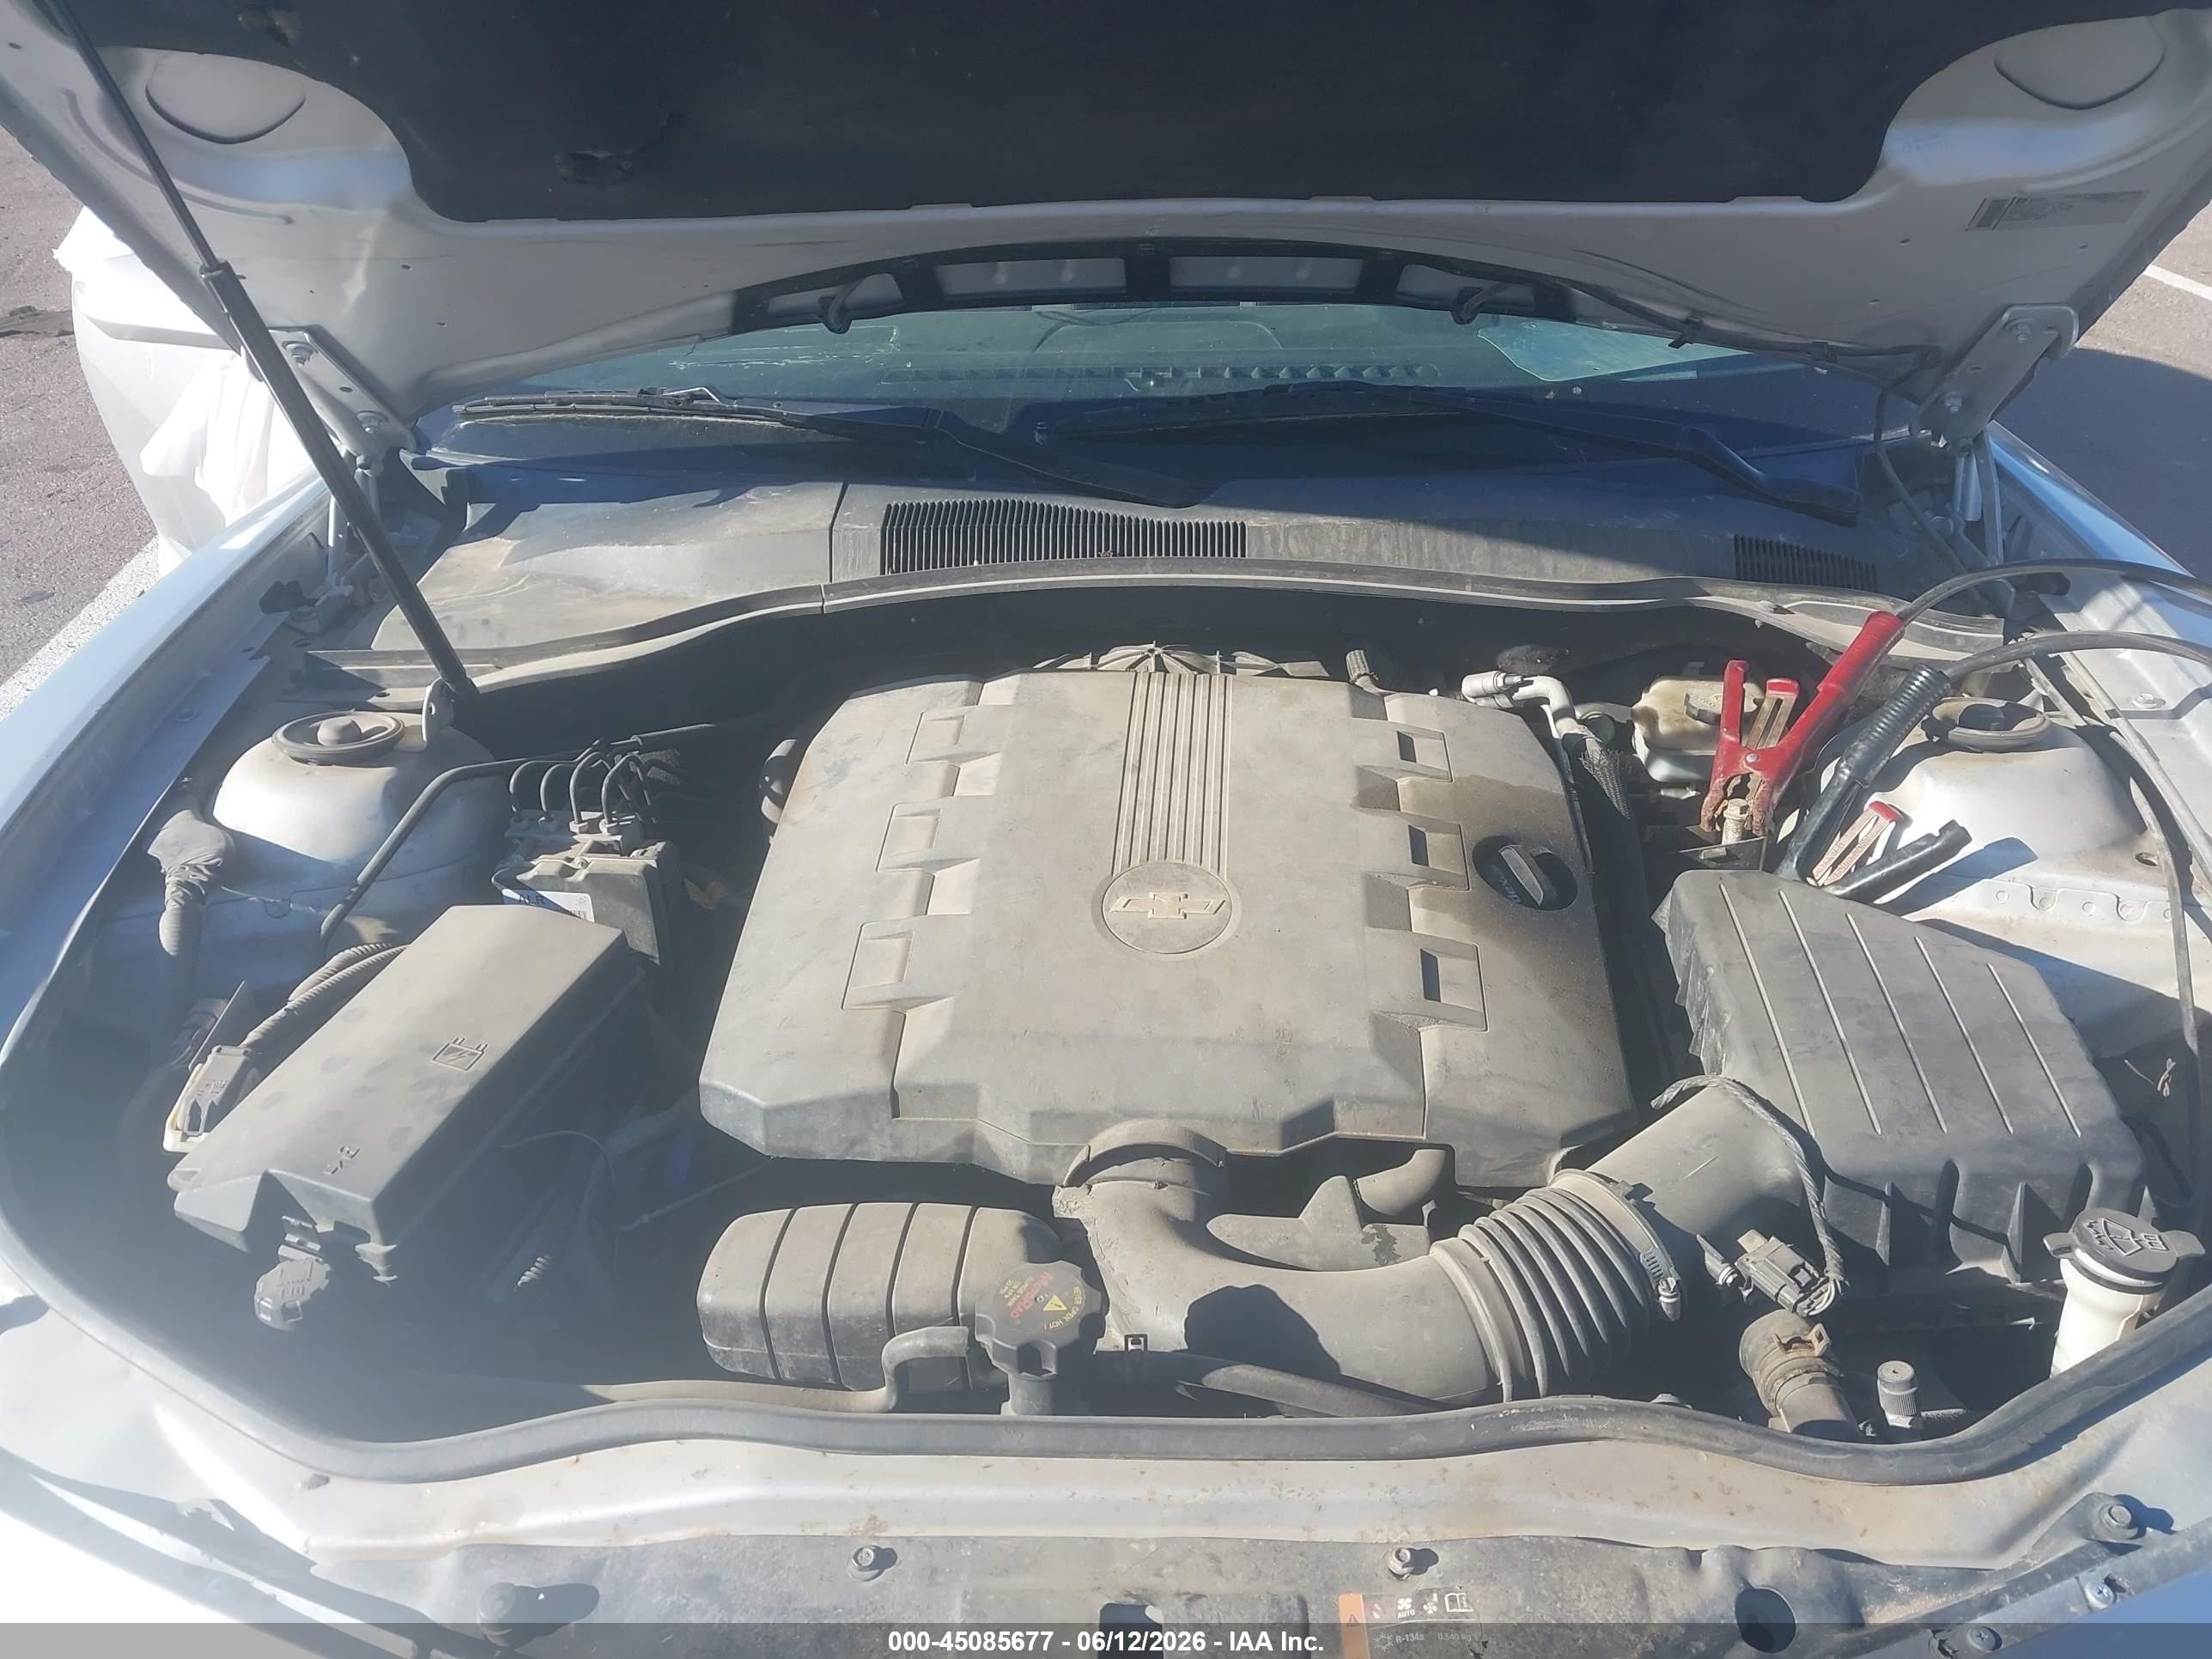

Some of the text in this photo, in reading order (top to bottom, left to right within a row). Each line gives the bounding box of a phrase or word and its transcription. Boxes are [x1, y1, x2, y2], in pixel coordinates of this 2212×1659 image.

[1048, 1319, 1063, 1329] HOT
[1397, 1609, 1415, 1619] AUTO
[1395, 1632, 1425, 1644] R-134a
